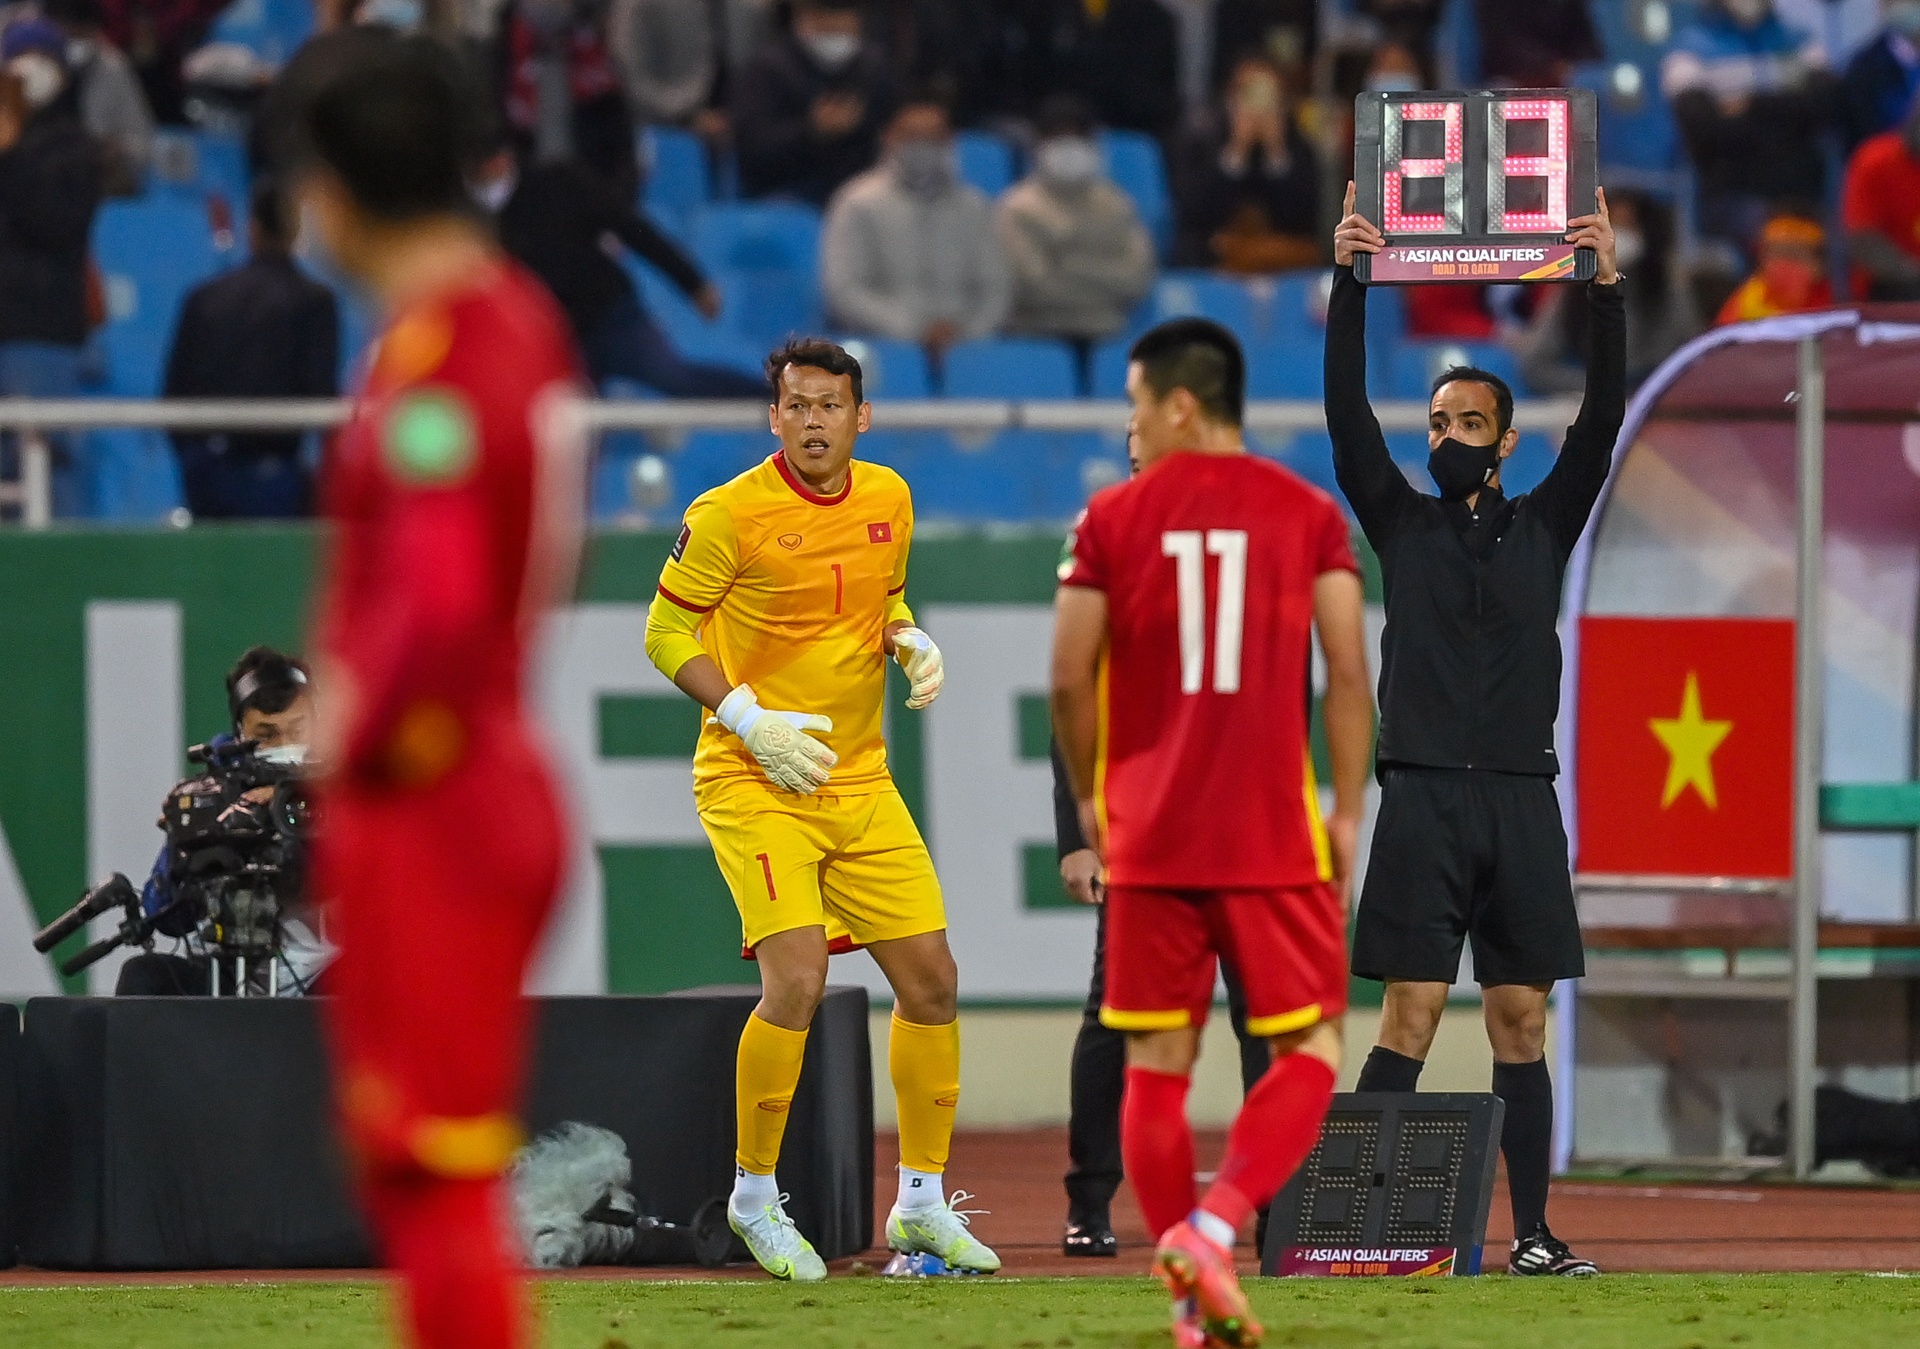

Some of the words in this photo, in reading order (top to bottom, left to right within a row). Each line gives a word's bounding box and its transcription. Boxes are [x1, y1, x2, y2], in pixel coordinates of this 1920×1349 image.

[1384, 100, 1568, 231] 23
[1405, 249, 1454, 262] ASIAN
[1456, 248, 1545, 262] QUALIFIERS
[1432, 263, 1456, 275] ROAD
[1458, 263, 1469, 275] TO
[1471, 263, 1499, 275] QATAR
[831, 563, 843, 615] 1
[1161, 528, 1249, 695] 11
[755, 852, 777, 902] 1
[1310, 1248, 1352, 1261] ASIAN
[1353, 1248, 1430, 1261] QUALIFIERS
